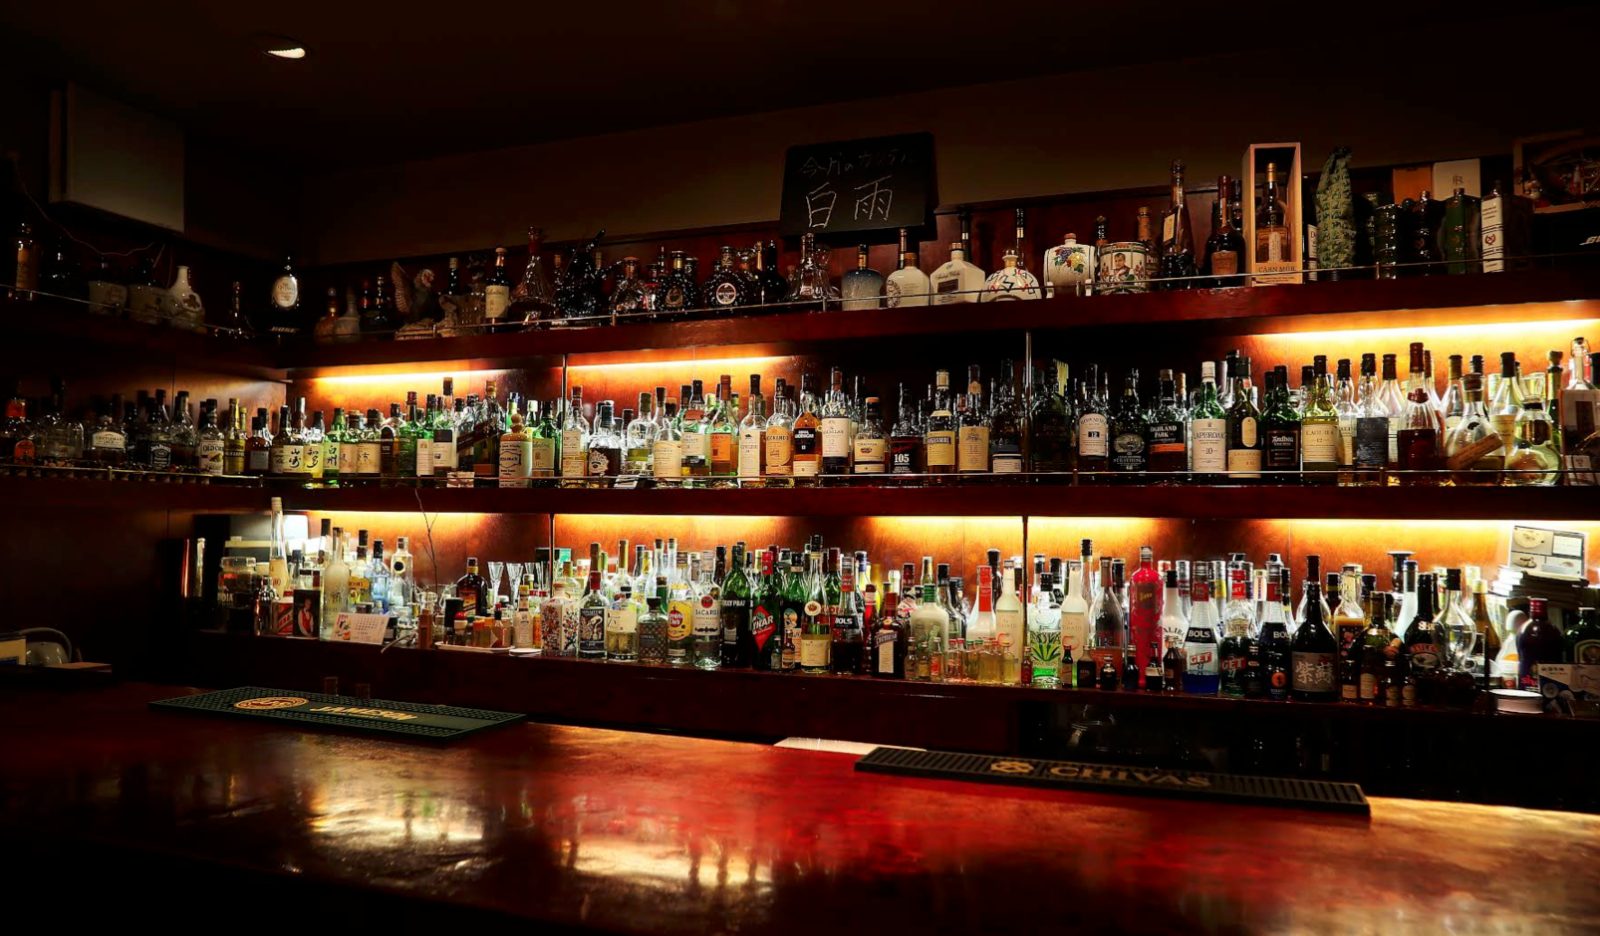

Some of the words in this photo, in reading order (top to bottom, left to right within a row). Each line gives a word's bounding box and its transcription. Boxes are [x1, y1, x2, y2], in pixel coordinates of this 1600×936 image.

[806, 175, 893, 228] 白雨
[894, 454, 910, 463] 105
[1188, 630, 1211, 638] BOLS
[1273, 631, 1290, 639] BOL
[1190, 653, 1211, 664] GET
[1222, 659, 1245, 669] GET
[1050, 766, 1211, 788] CHIVAS
